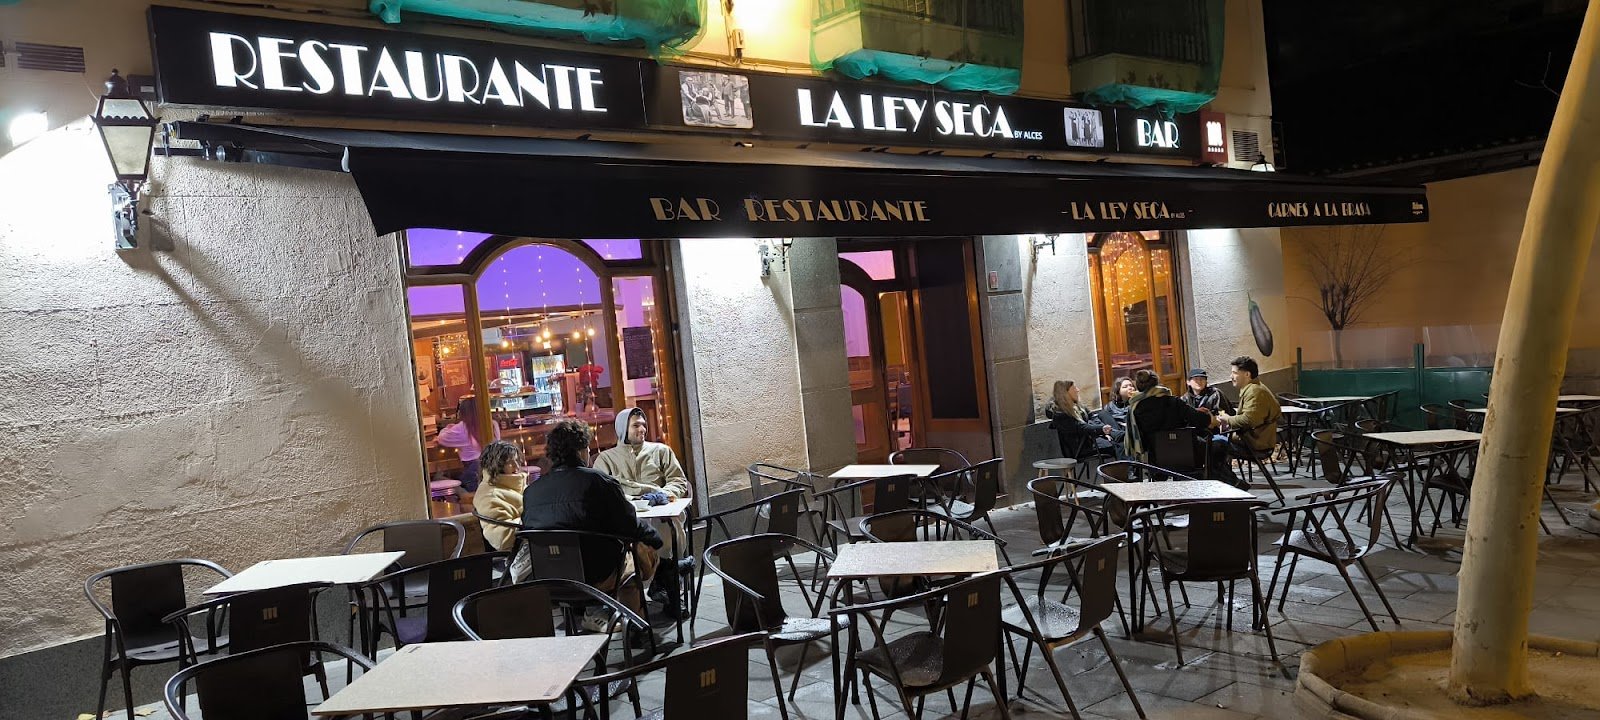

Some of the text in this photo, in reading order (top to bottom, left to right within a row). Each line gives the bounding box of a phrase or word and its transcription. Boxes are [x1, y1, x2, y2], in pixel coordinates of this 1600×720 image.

[208, 31, 608, 112] RESTAURANTE
[797, 88, 1043, 140] LA LEY SECA BY ALCES
[1136, 118, 1180, 149] BAR
[649, 197, 931, 222] BAR RESTAURANTE
[1070, 201, 1096, 220] LA
[1099, 201, 1128, 220] LEY
[1132, 201, 1170, 220] SECA
[1267, 202, 1371, 218] CARNES A LA BRASA
